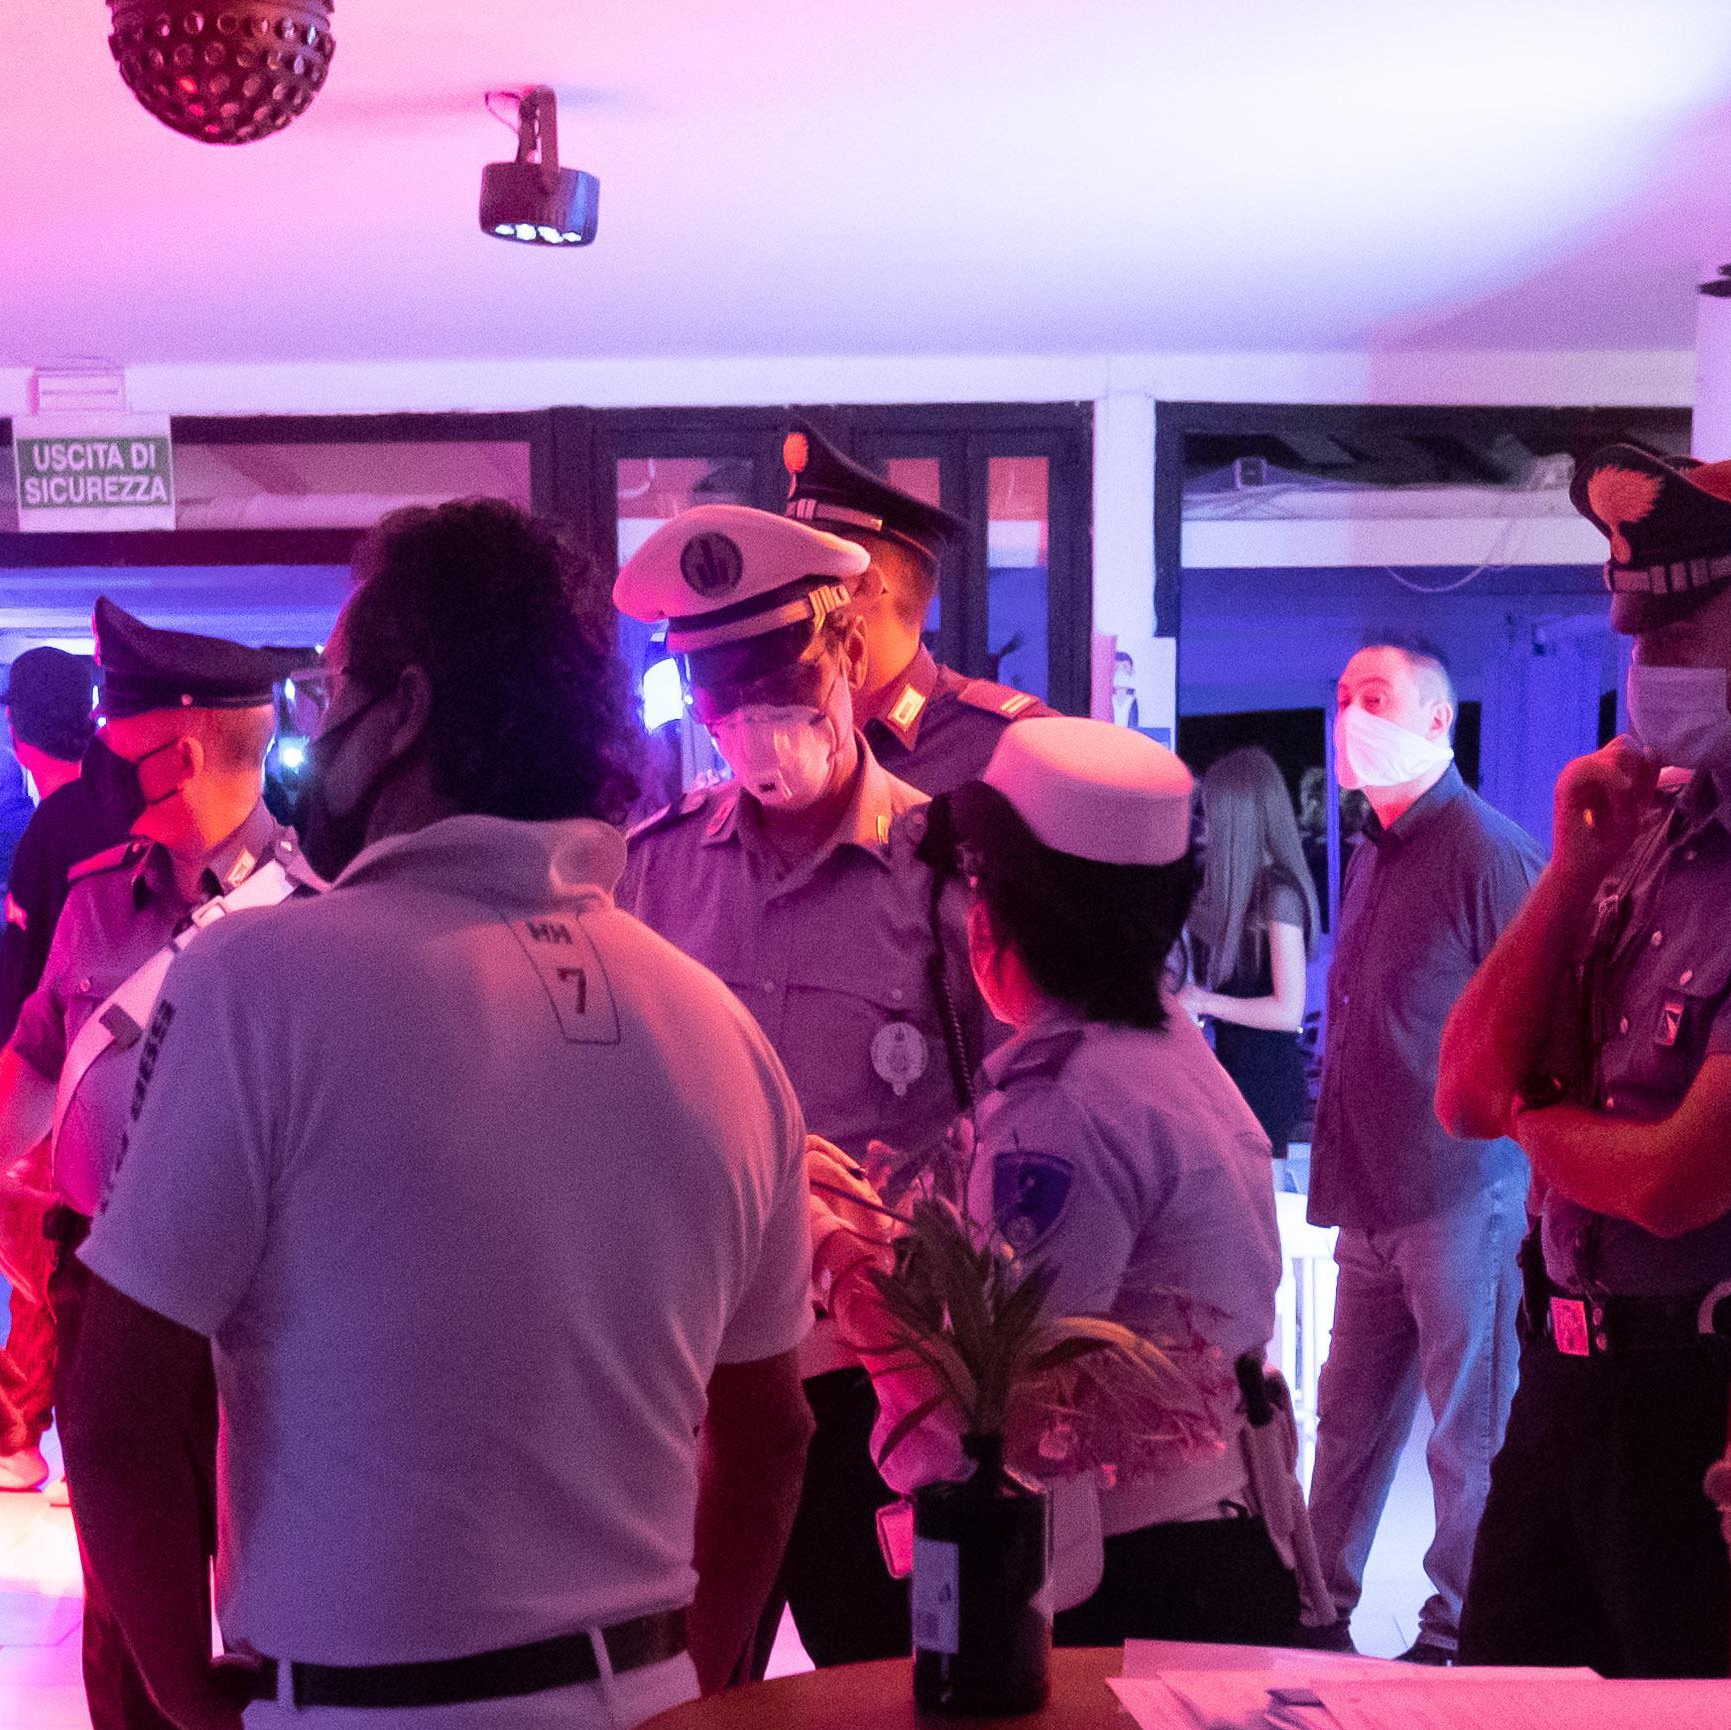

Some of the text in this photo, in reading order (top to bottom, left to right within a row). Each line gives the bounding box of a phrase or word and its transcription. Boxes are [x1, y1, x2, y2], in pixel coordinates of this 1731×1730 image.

[32, 442, 156, 471] USCITA DI
[24, 475, 168, 504] SICUREZZA
[556, 968, 587, 1015] 7
